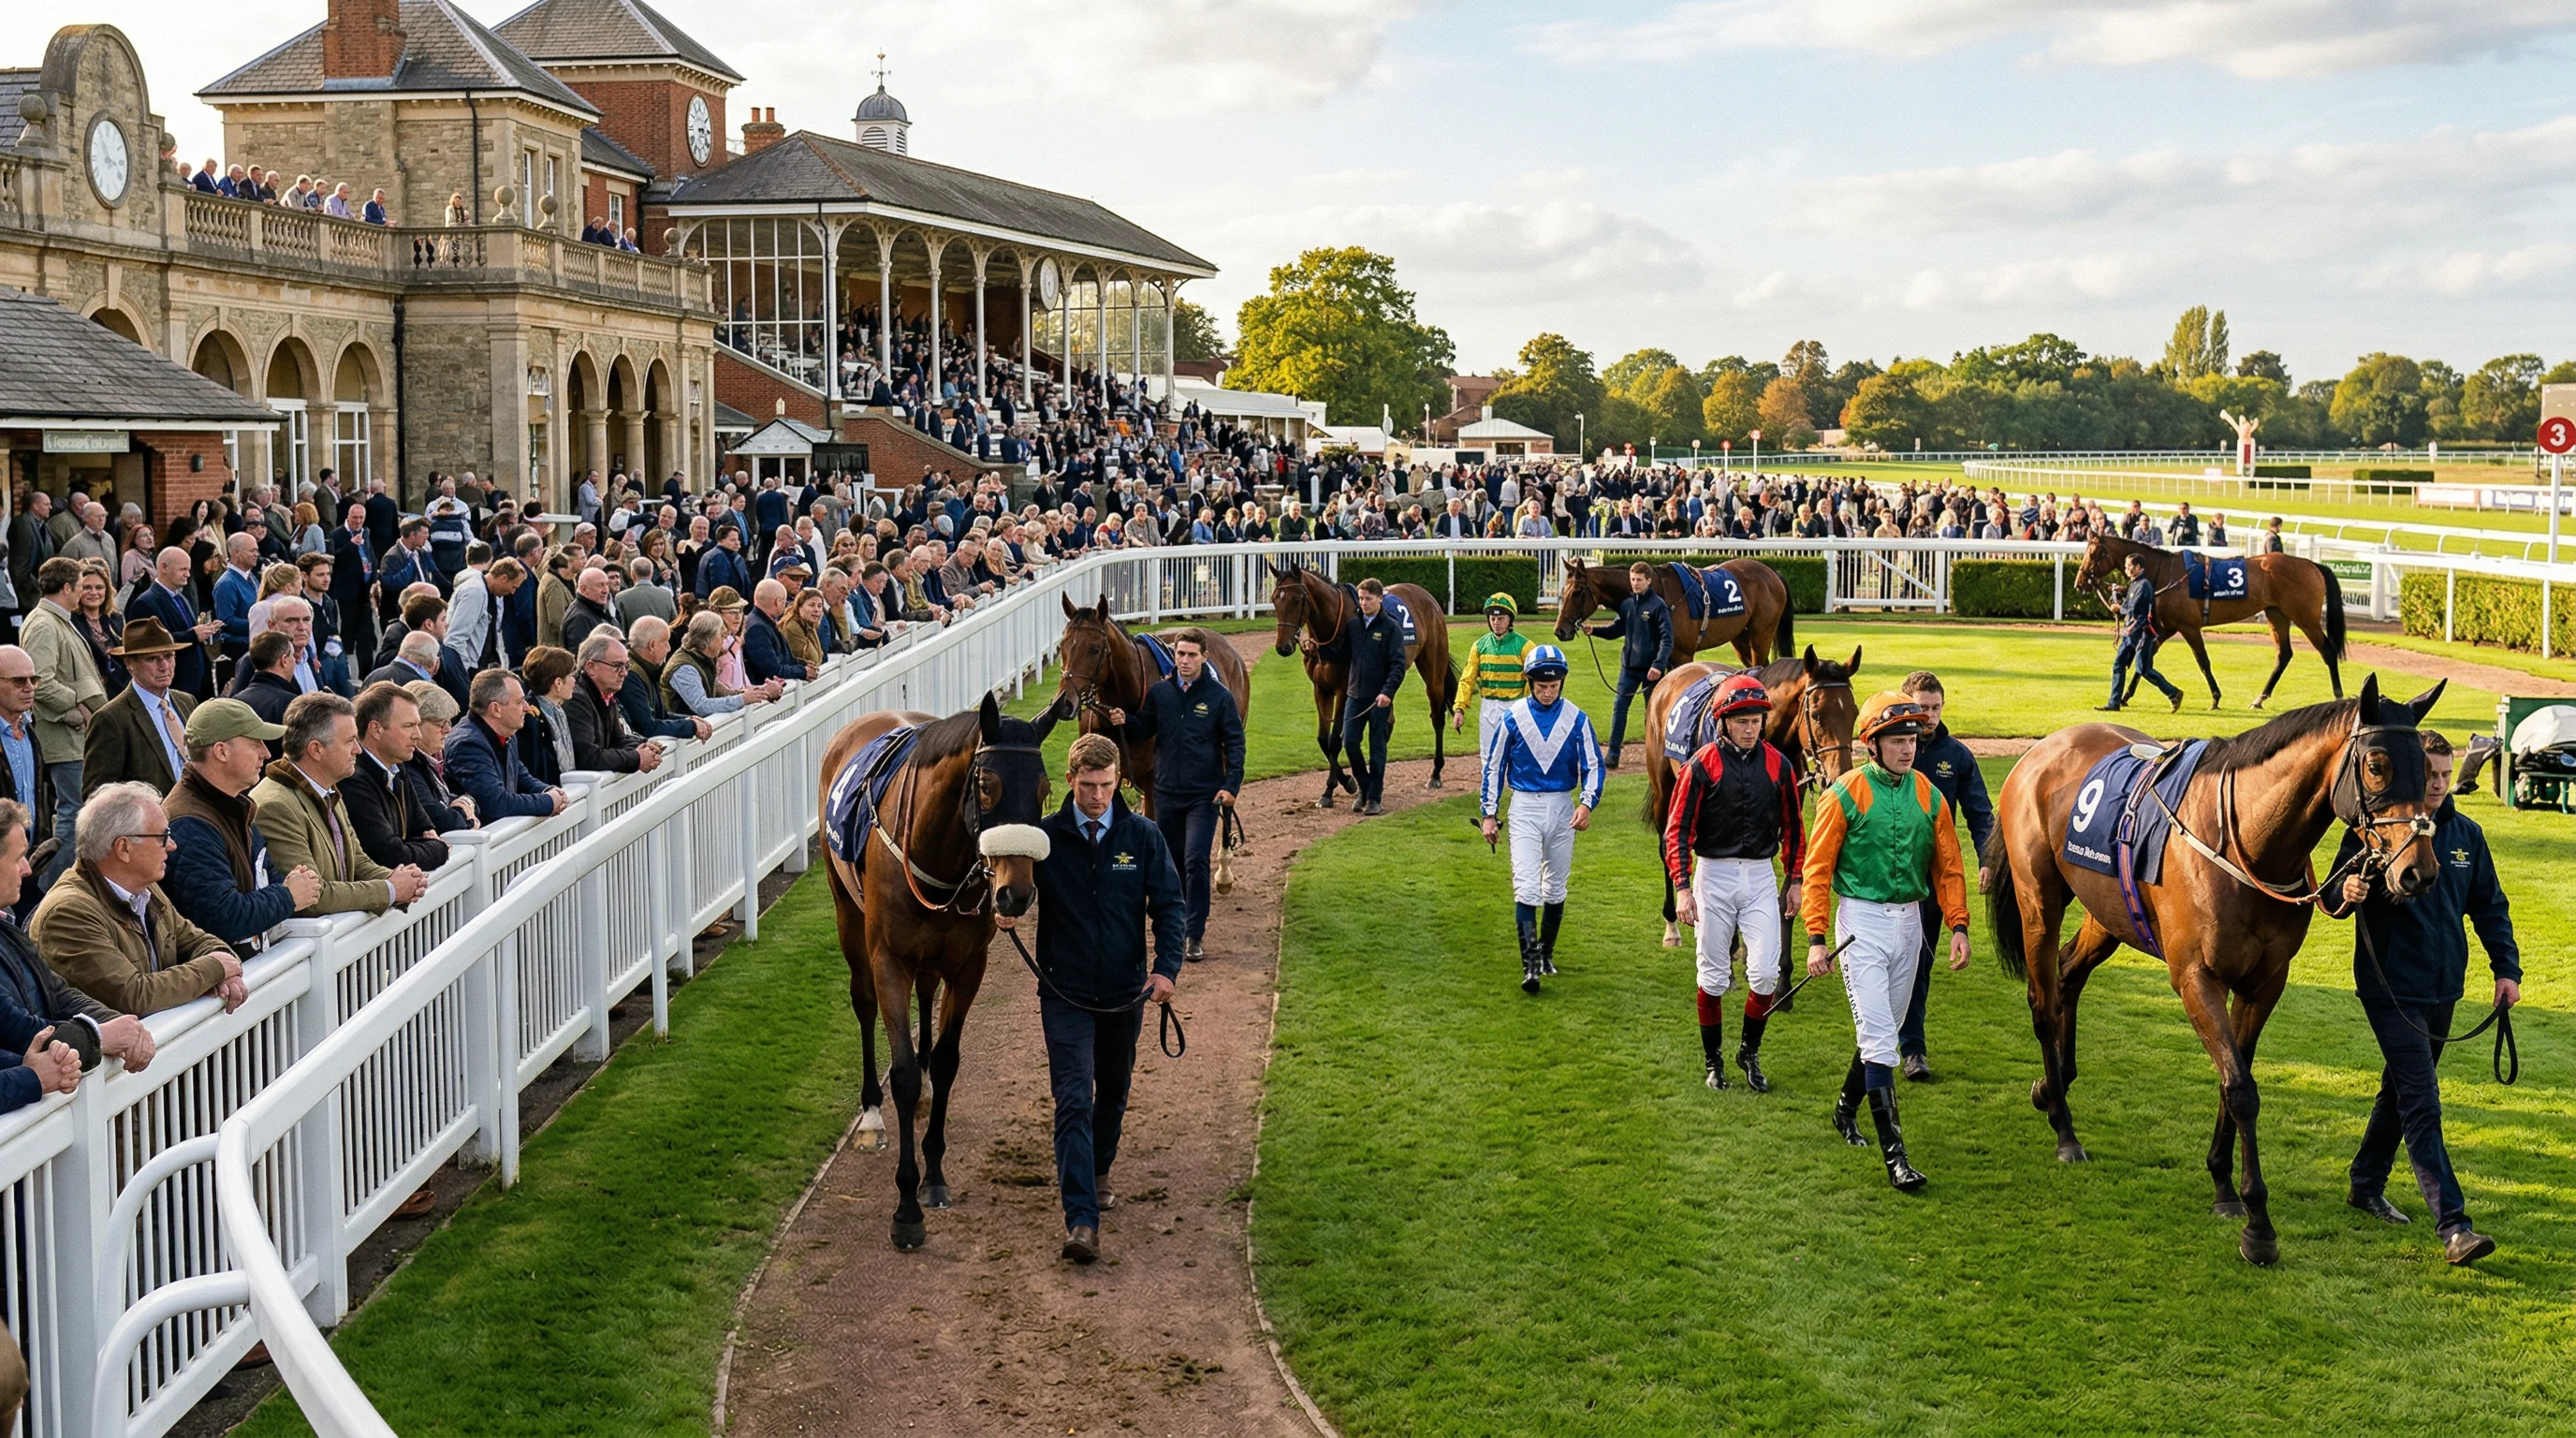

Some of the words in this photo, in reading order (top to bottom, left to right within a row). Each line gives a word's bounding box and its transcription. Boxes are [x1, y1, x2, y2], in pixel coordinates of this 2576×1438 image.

[2550, 423, 2566, 447] 3
[2227, 567, 2244, 588] 3
[1723, 580, 1742, 603] 2
[1397, 604, 1414, 628] 2
[1666, 695, 1690, 735] 5
[830, 763, 858, 817] 4
[2072, 778, 2105, 833] 9
